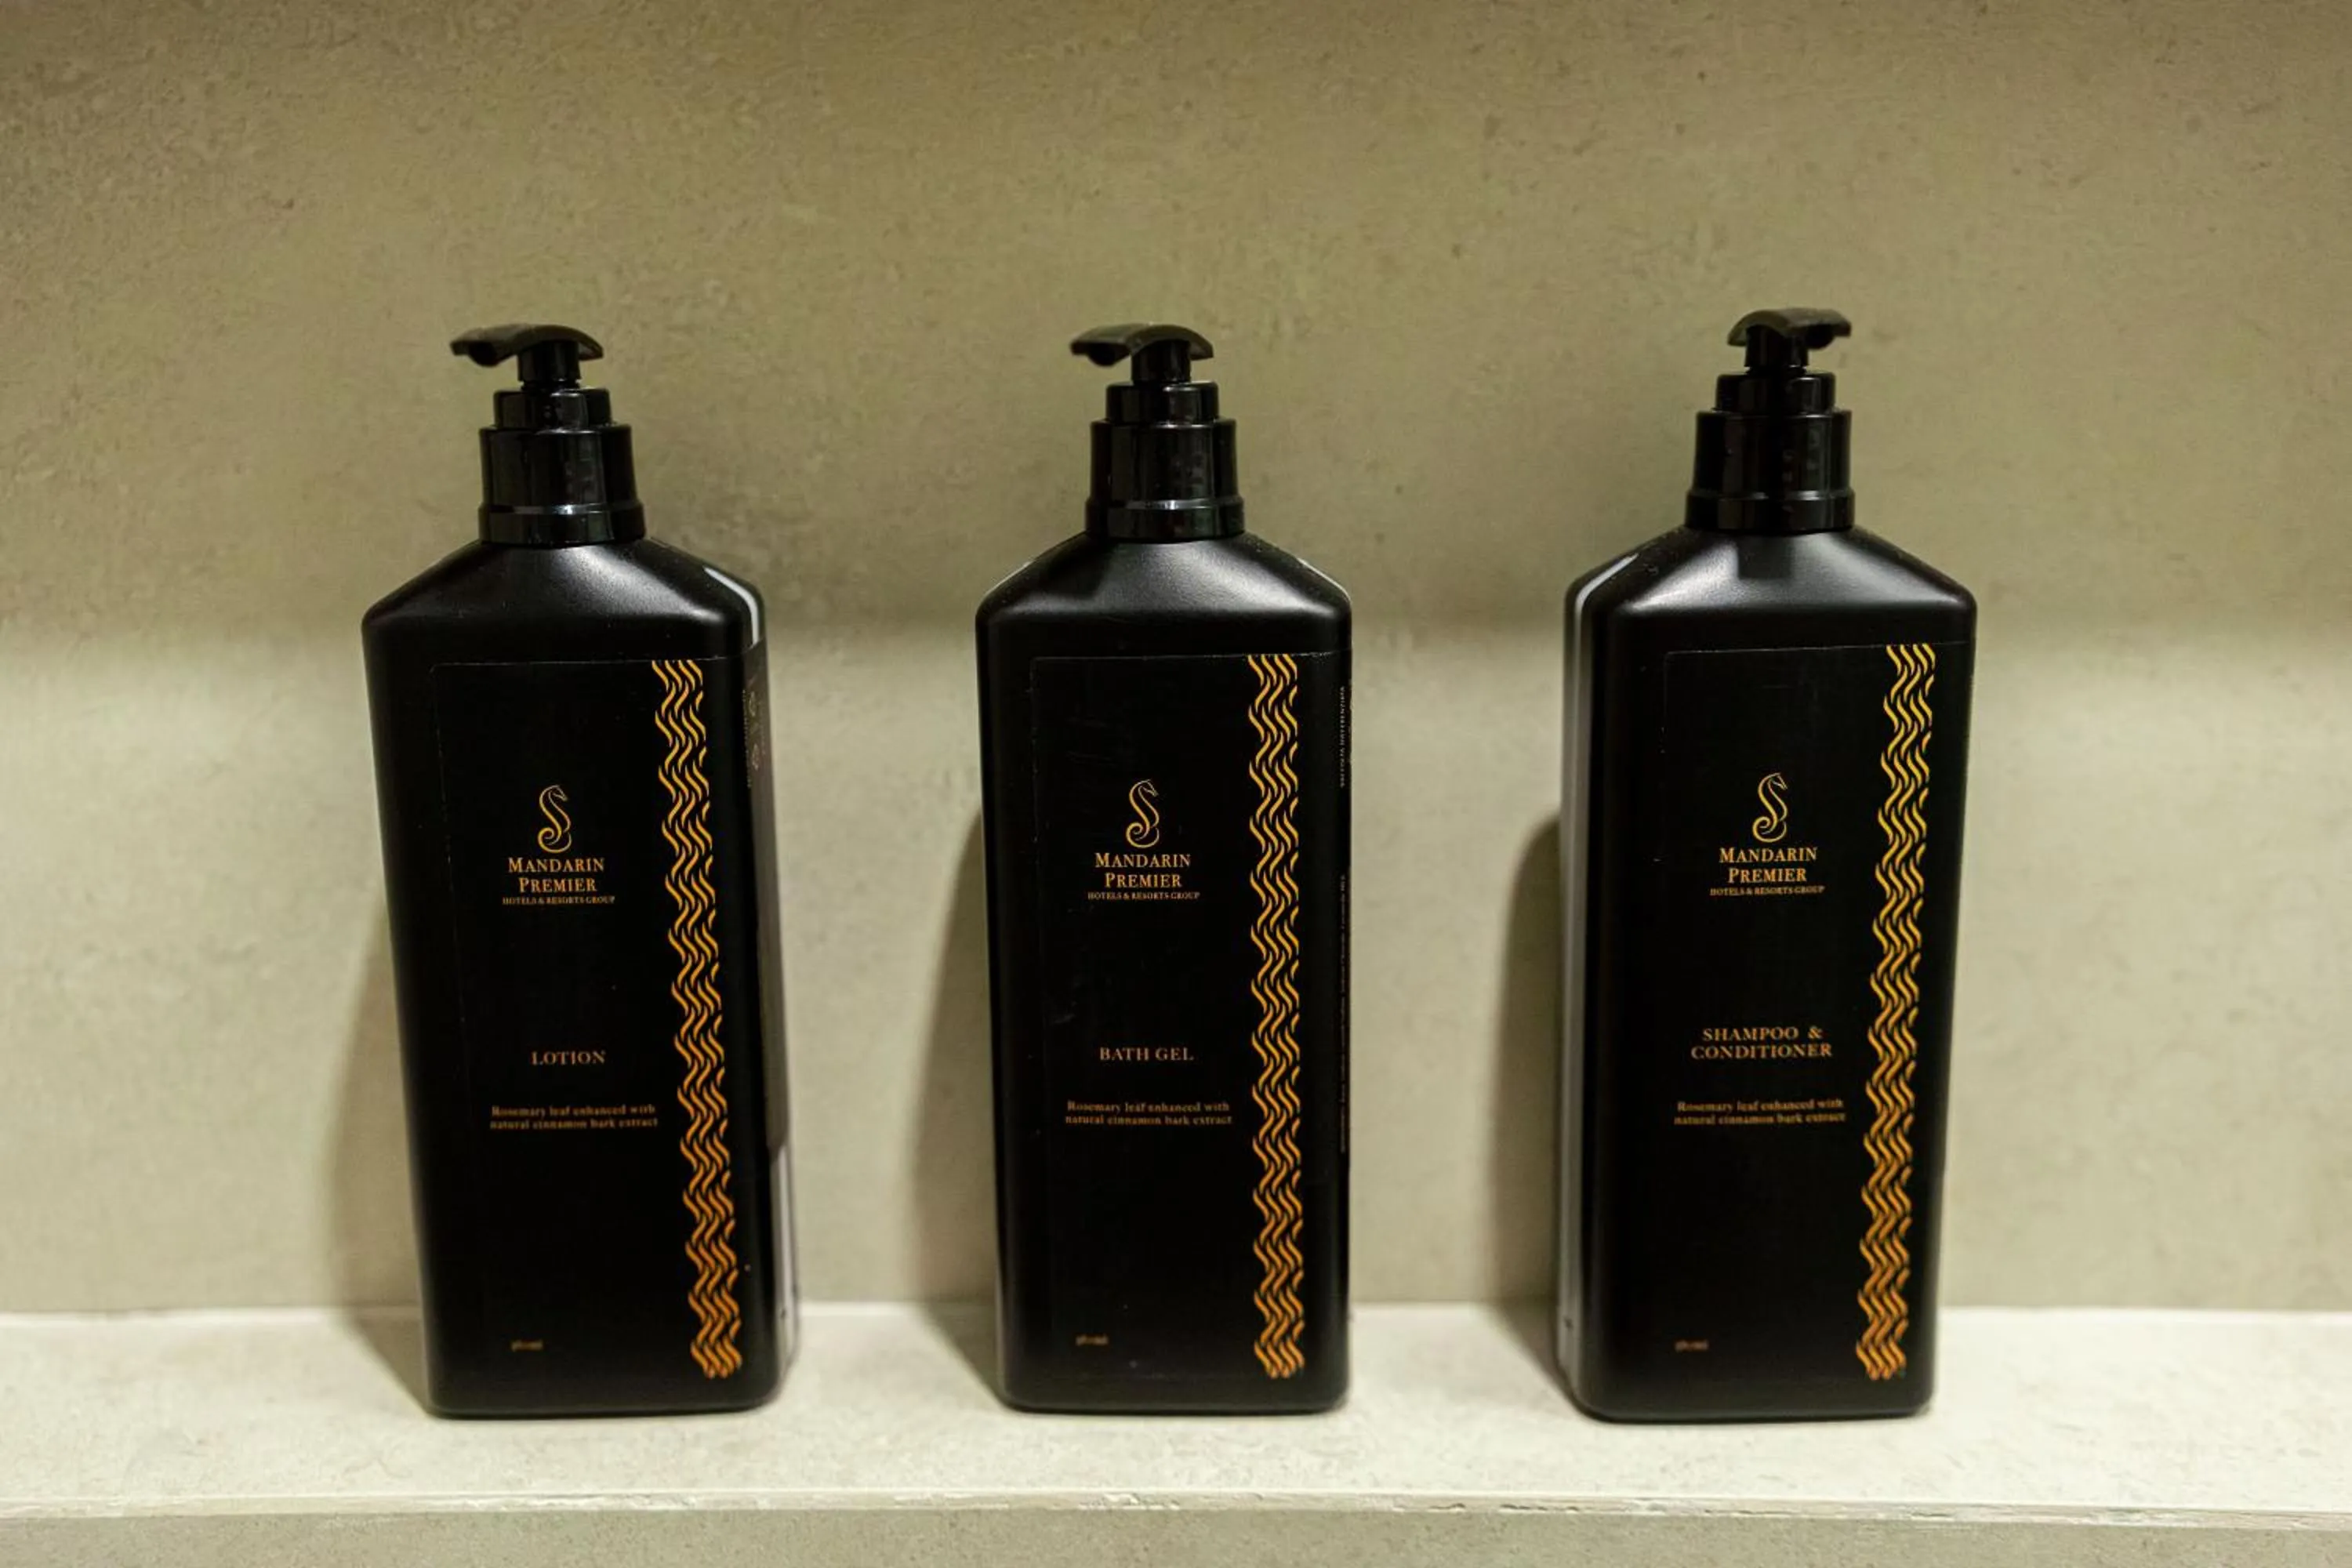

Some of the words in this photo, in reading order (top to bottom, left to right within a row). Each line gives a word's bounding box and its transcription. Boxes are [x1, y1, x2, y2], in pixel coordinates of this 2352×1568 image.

[1094, 852, 1191, 868] MANDARIN
[1719, 846, 1818, 863] MANDARIN
[508, 856, 605, 873] MANDARIN
[1104, 872, 1182, 888] PREMIER
[1727, 867, 1807, 884] PREMIER
[518, 877, 597, 894] PREMIER
[1701, 1026, 1799, 1042] SHAMPOO
[1807, 1025, 1823, 1040] &
[530, 1051, 607, 1066] LOTION
[1099, 1047, 1149, 1062] BATH
[1154, 1047, 1196, 1062] GEL
[1690, 1043, 1833, 1060] CONDITIONER
[572, 1104, 626, 1116] enhanced
[630, 1104, 656, 1114] with
[1148, 1101, 1201, 1112] enhanced
[1203, 1101, 1230, 1112] with
[1760, 1099, 1815, 1112] enhanced
[1817, 1098, 1844, 1110] with
[489, 1119, 530, 1131] natural
[1065, 1114, 1105, 1125] natural
[1673, 1114, 1716, 1126] natural
